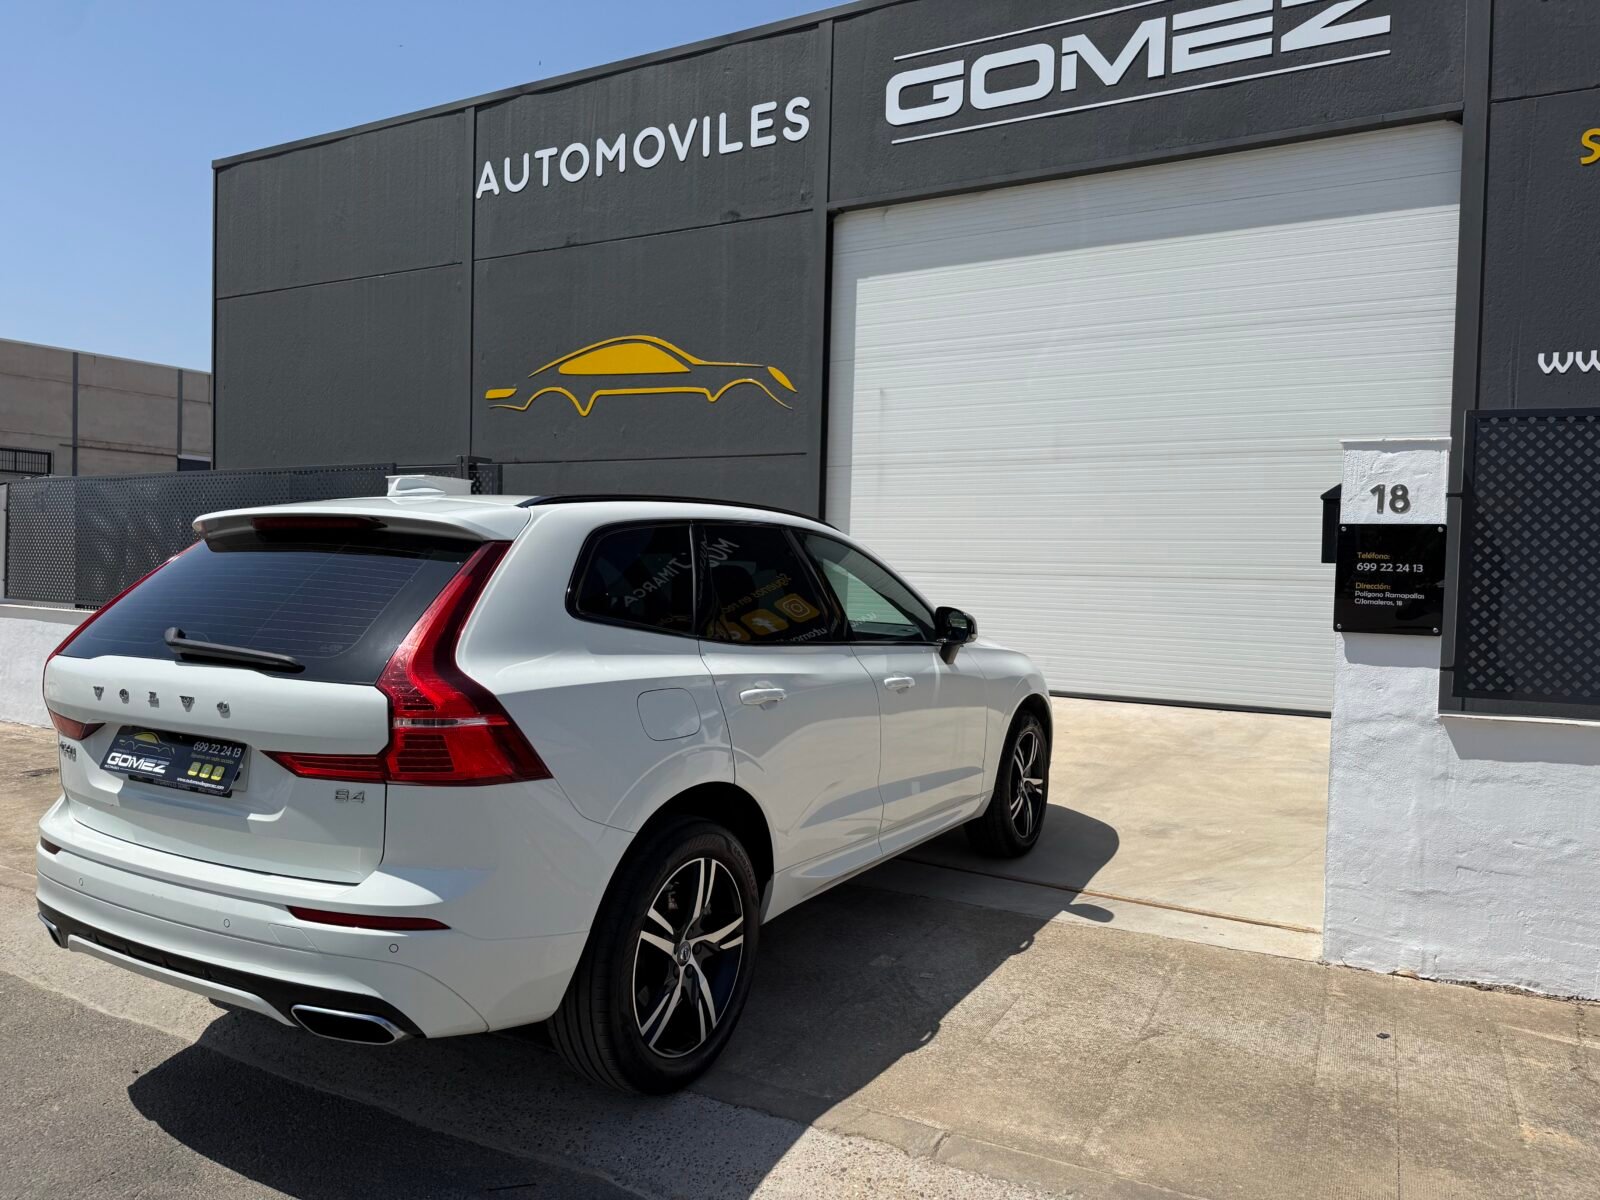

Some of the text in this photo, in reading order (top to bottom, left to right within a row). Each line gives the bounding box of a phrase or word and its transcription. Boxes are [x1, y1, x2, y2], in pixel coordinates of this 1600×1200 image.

[885, 0, 1391, 126] GOMEZ
[475, 96, 811, 200] AUTOMOVILES
[1370, 484, 1411, 514] 18
[1357, 552, 1391, 560] Teléfono:
[1356, 562, 1424, 573] 699 22 24 13
[1355, 582, 1391, 590] Dirección:
[93, 686, 230, 717] VOLVO
[193, 741, 242, 758] 699 22 24 13
[107, 752, 166, 772] GOMEZ
